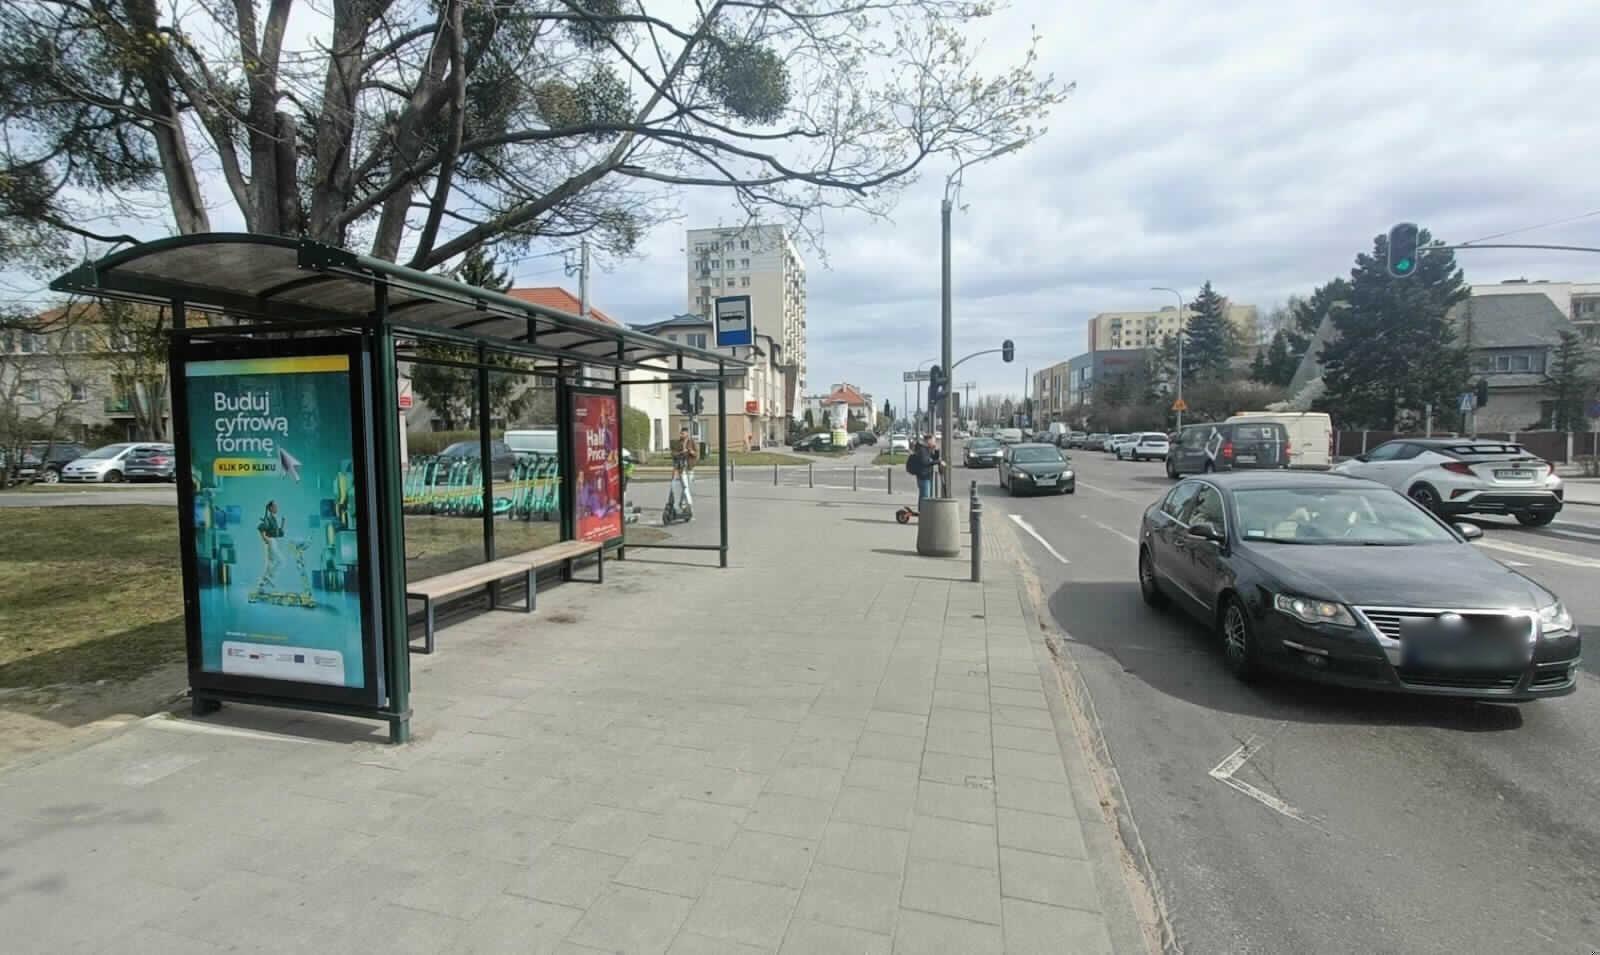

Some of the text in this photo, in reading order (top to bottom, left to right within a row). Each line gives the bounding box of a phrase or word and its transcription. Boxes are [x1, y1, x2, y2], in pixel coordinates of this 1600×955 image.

[214, 391, 270, 415] Buduj
[215, 412, 289, 436] cyfrową
[216, 434, 274, 456] formę
[586, 428, 606, 448] Half
[586, 448, 607, 463] Price
[218, 463, 276, 472] KLIK PO KLIKU
